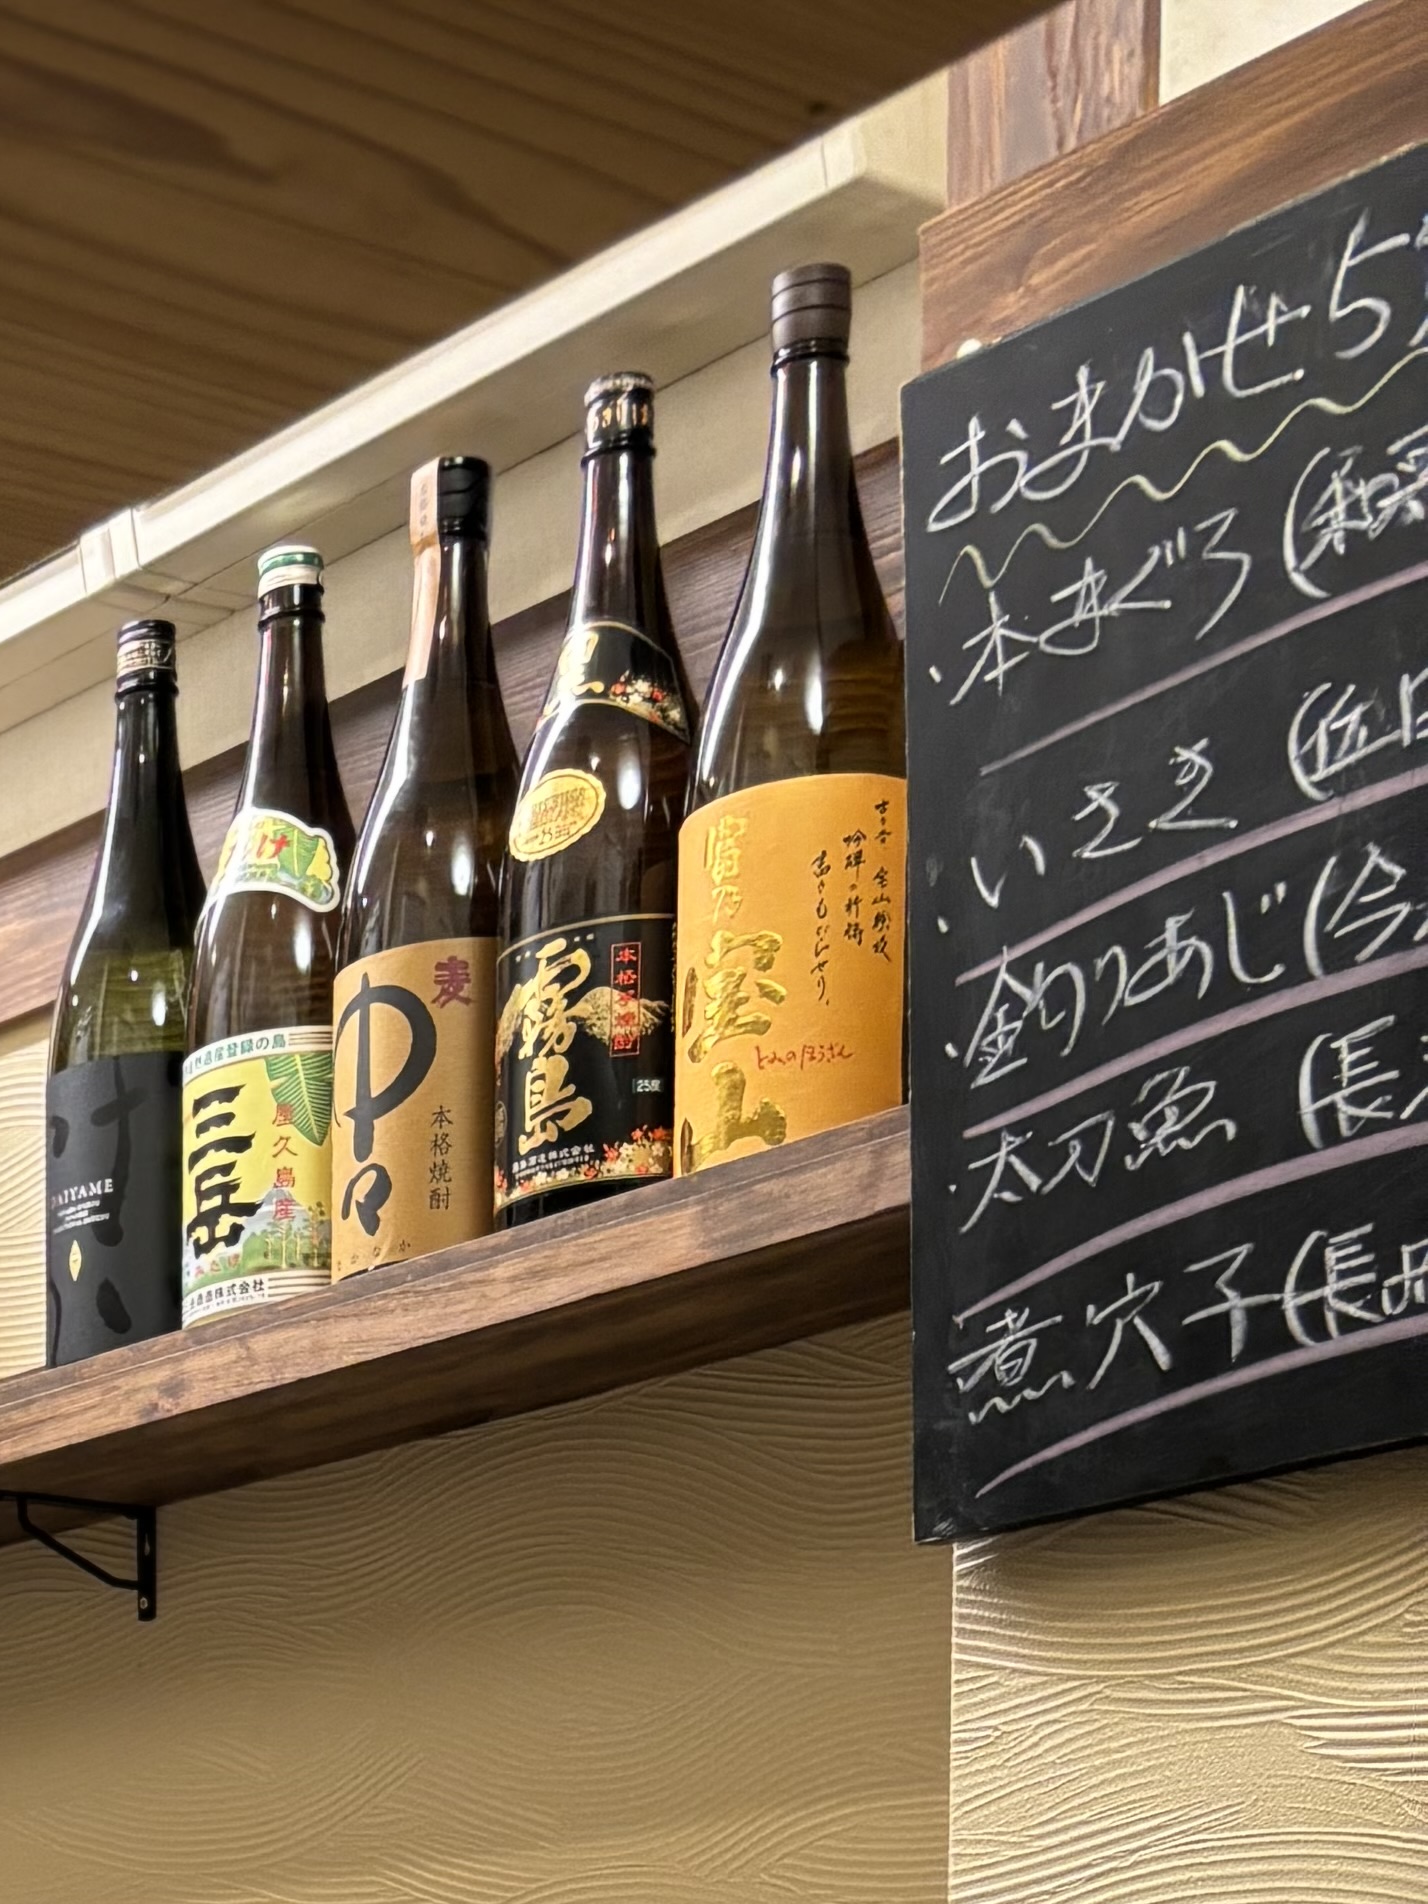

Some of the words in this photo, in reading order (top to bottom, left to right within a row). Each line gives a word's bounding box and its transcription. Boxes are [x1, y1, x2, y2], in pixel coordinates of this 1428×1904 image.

[926, 207, 1428, 533] おまかせ5
[431, 955, 472, 1009] 麦
[635, 1078, 662, 1093] 25度
[187, 1083, 264, 1261] 三岳
[272, 1103, 298, 1221] 屋久島産
[429, 1105, 455, 1211] 本格焼酎
